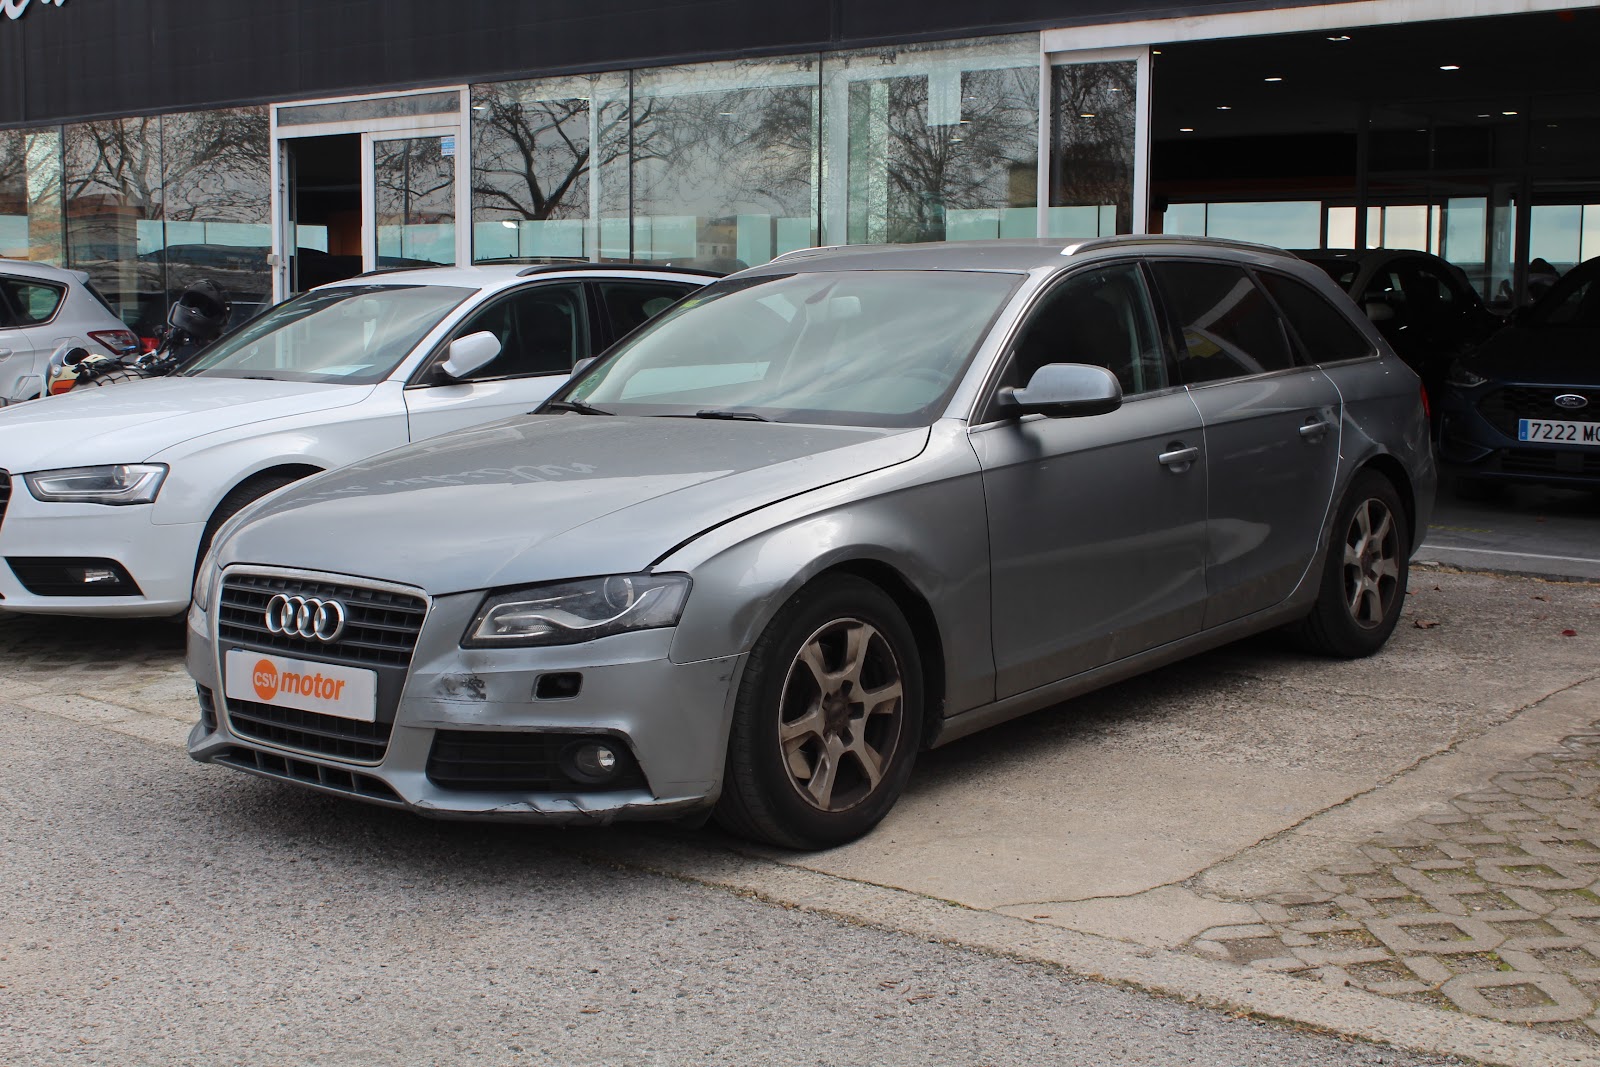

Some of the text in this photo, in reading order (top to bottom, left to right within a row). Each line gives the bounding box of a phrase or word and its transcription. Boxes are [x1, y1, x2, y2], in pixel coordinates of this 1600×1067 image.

[1532, 423, 1576, 440] 7222
[254, 671, 346, 701] CSV motor
